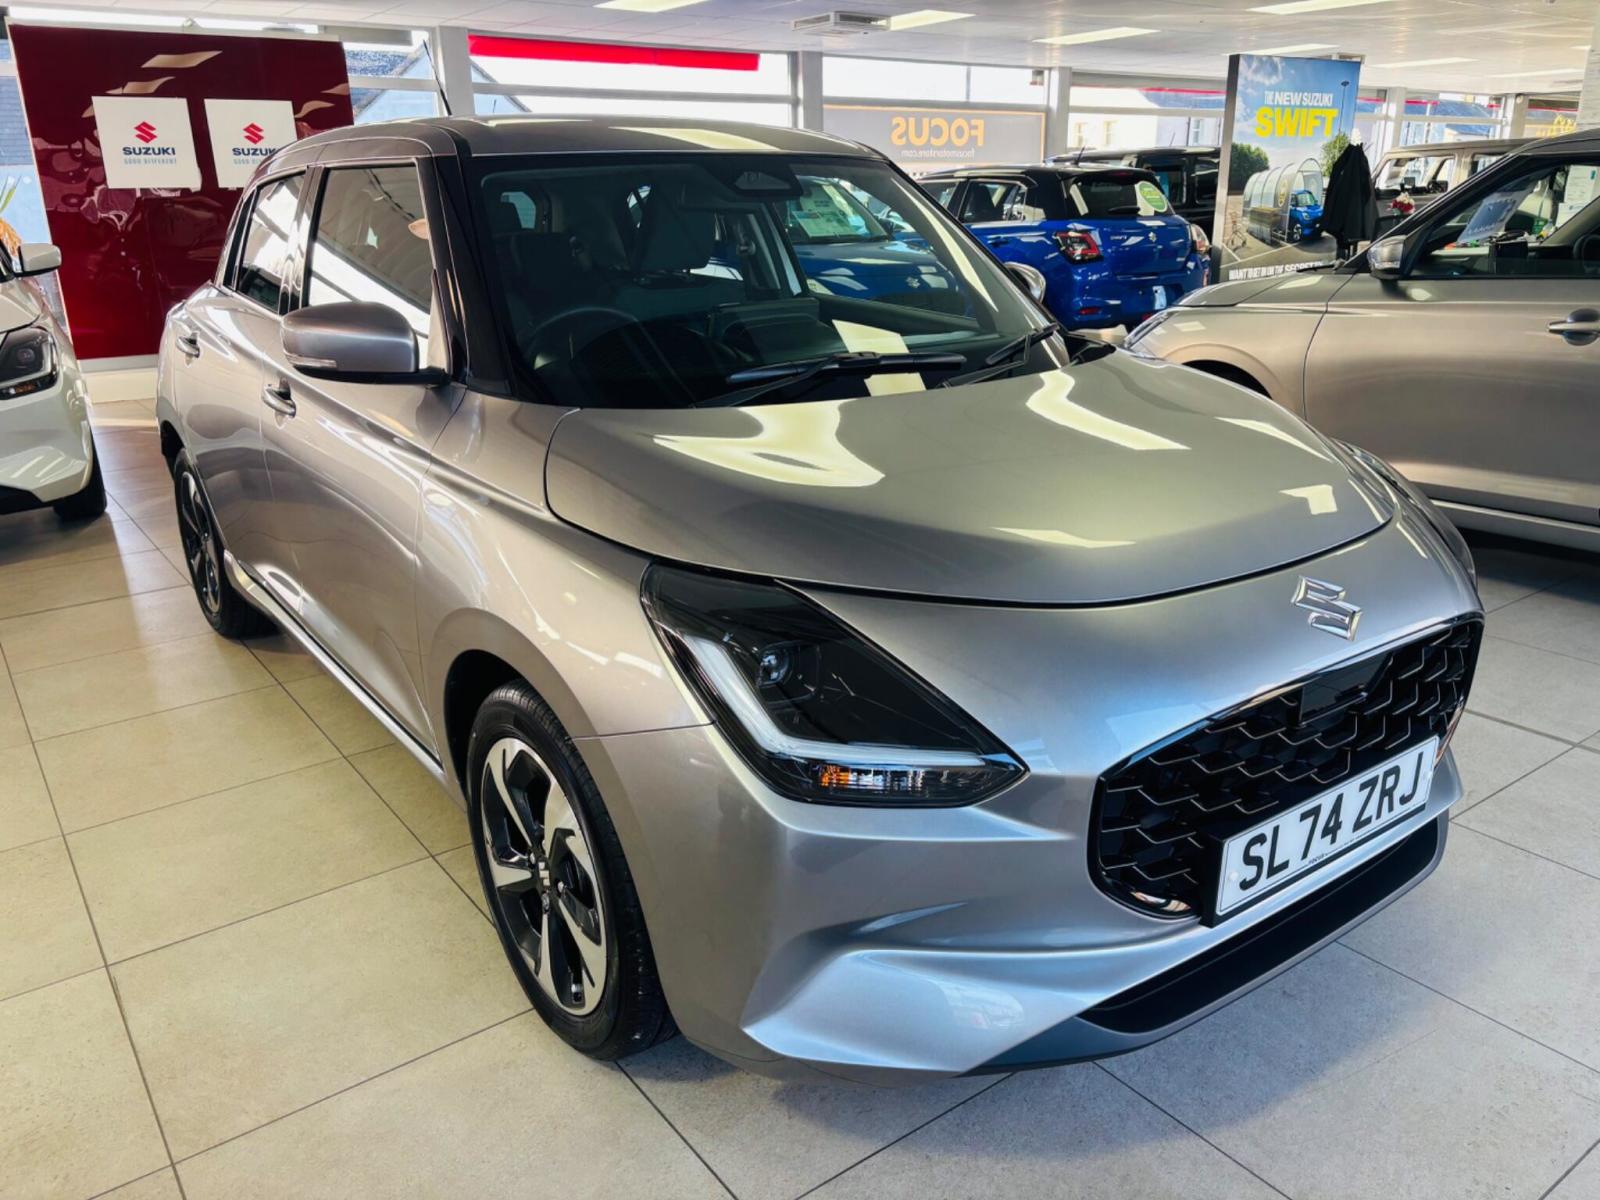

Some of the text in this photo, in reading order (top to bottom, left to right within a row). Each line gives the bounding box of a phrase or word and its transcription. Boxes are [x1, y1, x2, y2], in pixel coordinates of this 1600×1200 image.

[1264, 90, 1333, 106] THE NEW SUZUKI
[1255, 106, 1339, 138] SWIFT
[122, 146, 176, 156] SUZUKI
[232, 147, 277, 156] SUZUK
[1239, 751, 1424, 891] SL 74 ZRJ
